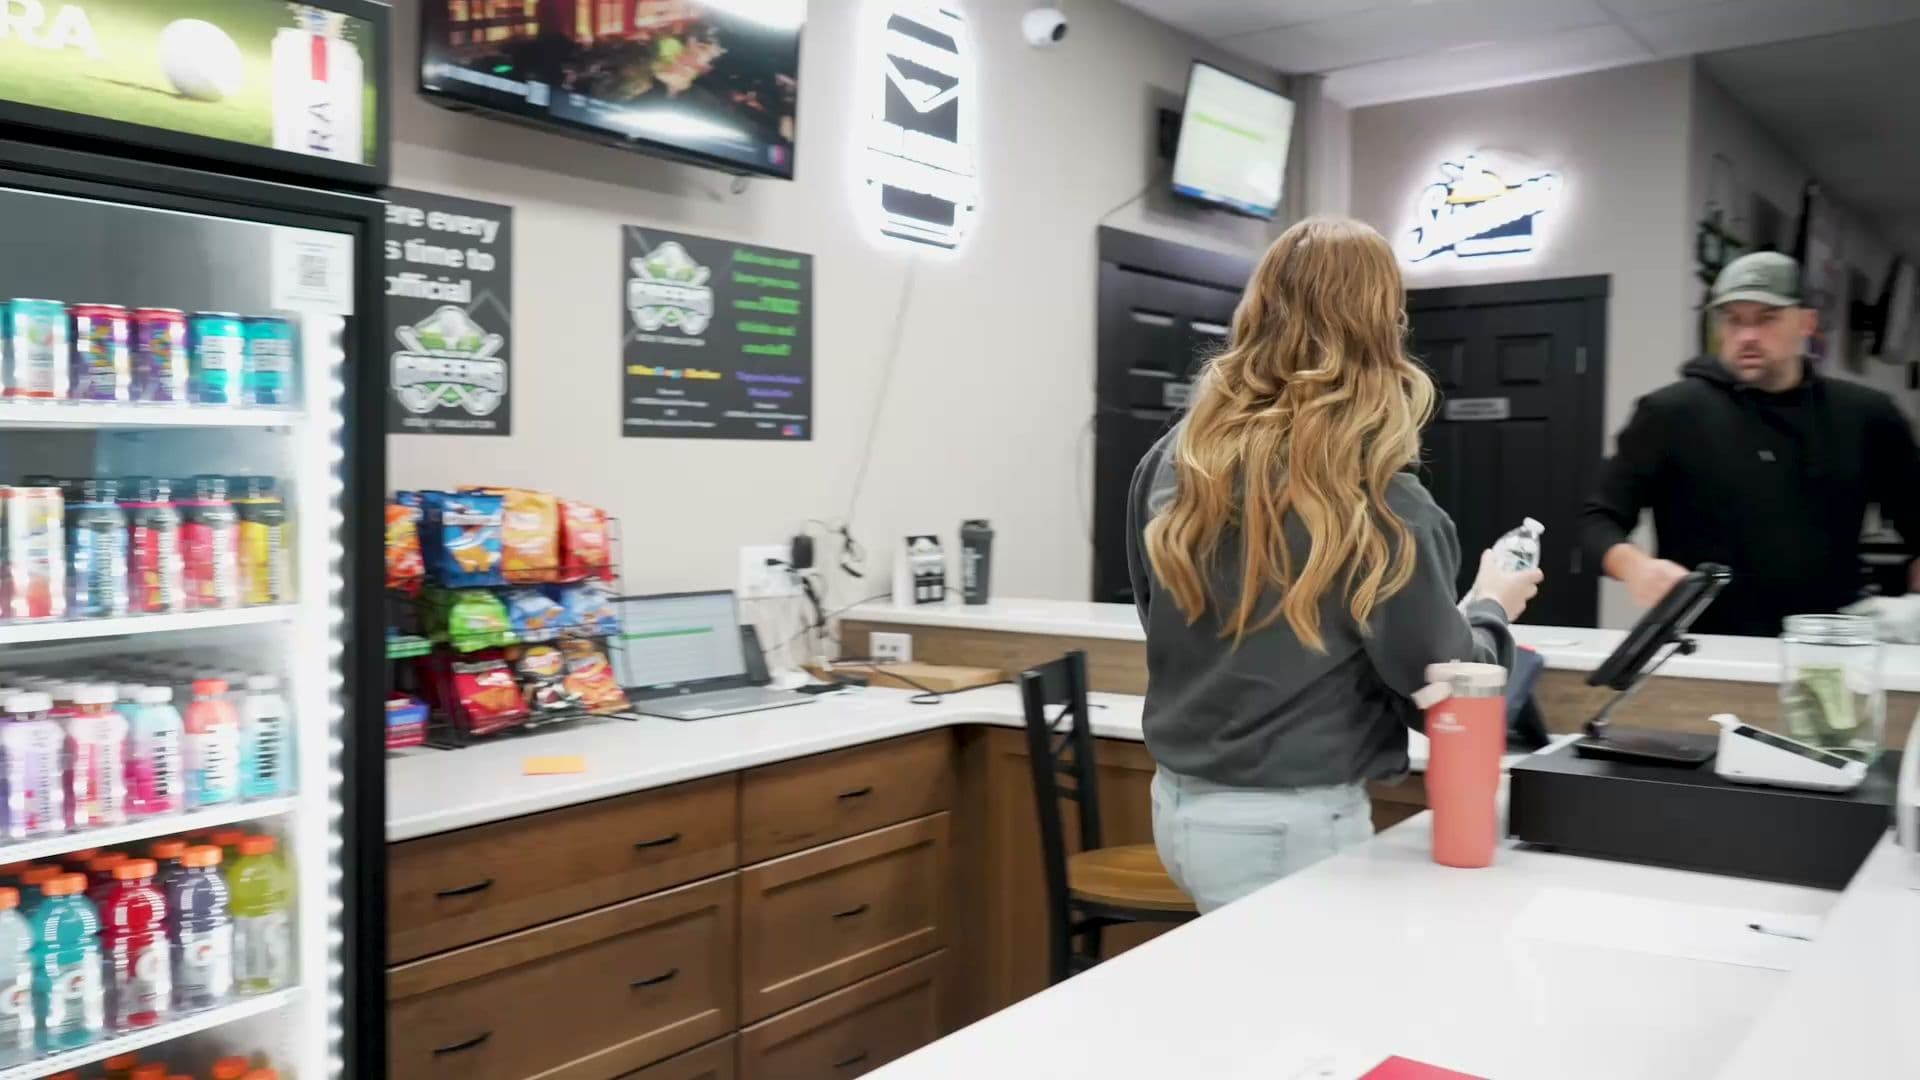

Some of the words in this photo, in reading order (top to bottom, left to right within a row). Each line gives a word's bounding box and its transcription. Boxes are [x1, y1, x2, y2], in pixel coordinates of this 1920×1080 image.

[427, 211, 499, 243] every
[404, 238, 464, 268] time
[466, 249, 495, 271] to
